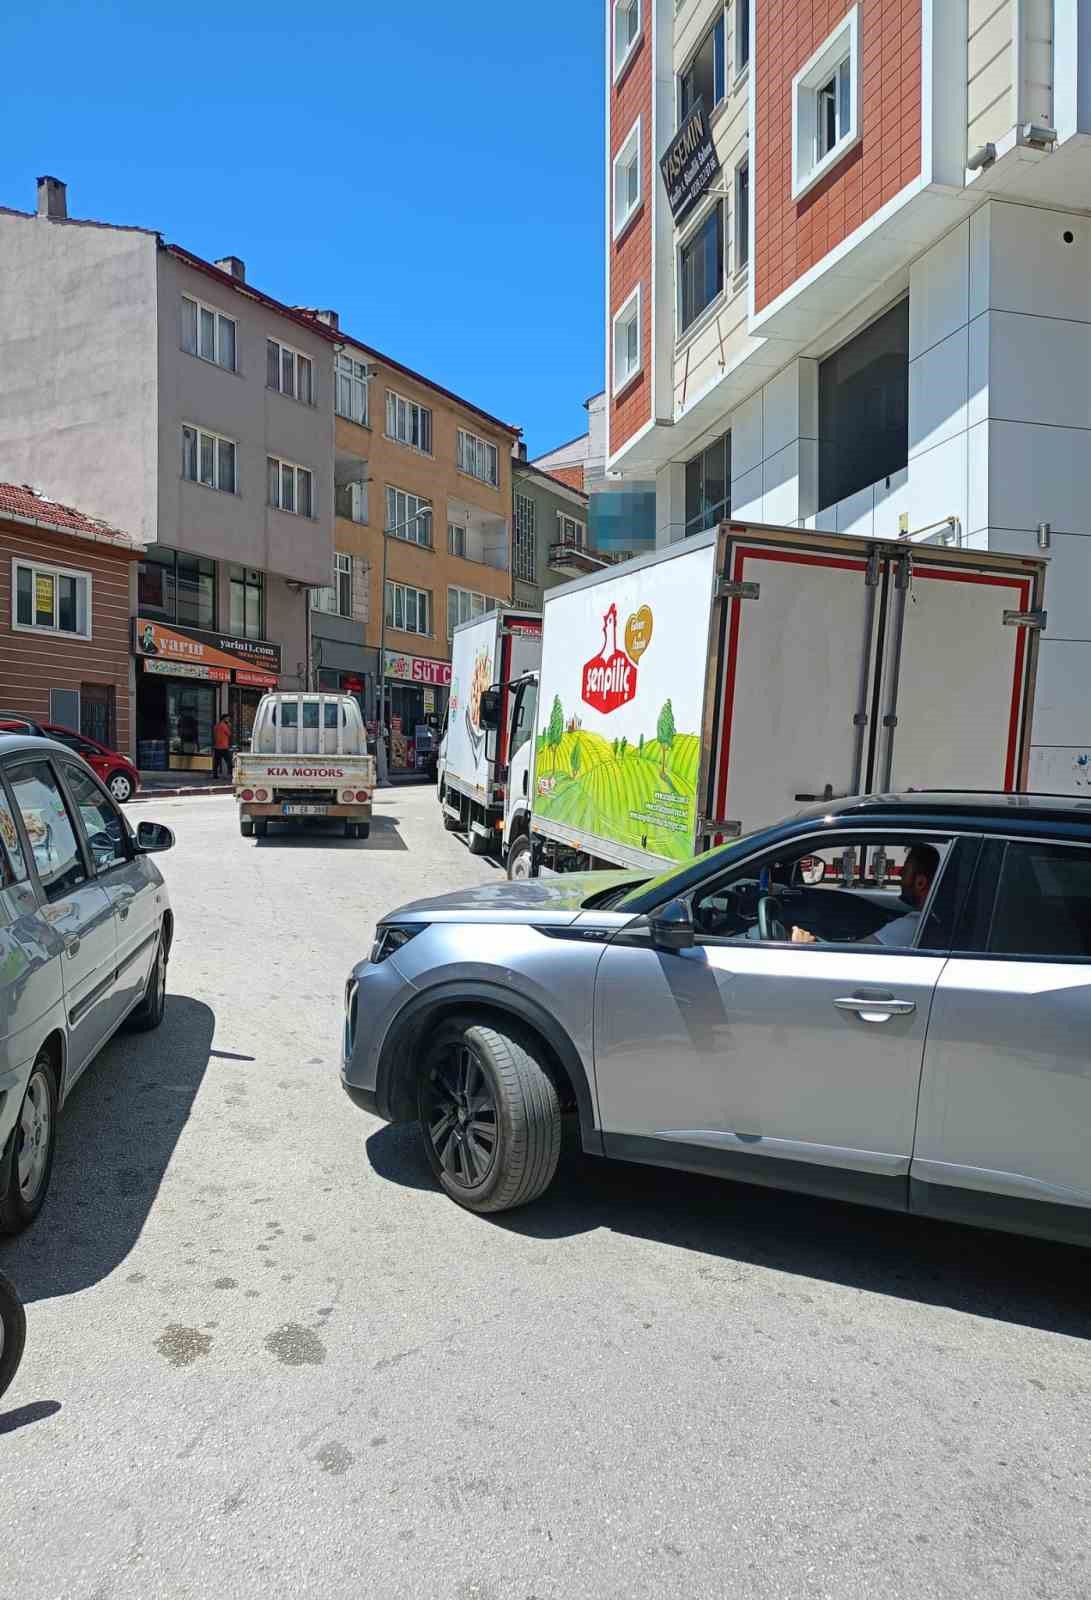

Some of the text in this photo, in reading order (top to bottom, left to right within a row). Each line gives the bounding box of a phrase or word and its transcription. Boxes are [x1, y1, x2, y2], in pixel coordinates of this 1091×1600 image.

[662, 110, 704, 190] YASEMİN
[586, 657, 631, 700] şenpiliç
[267, 767, 344, 778] KIA MOTORS
